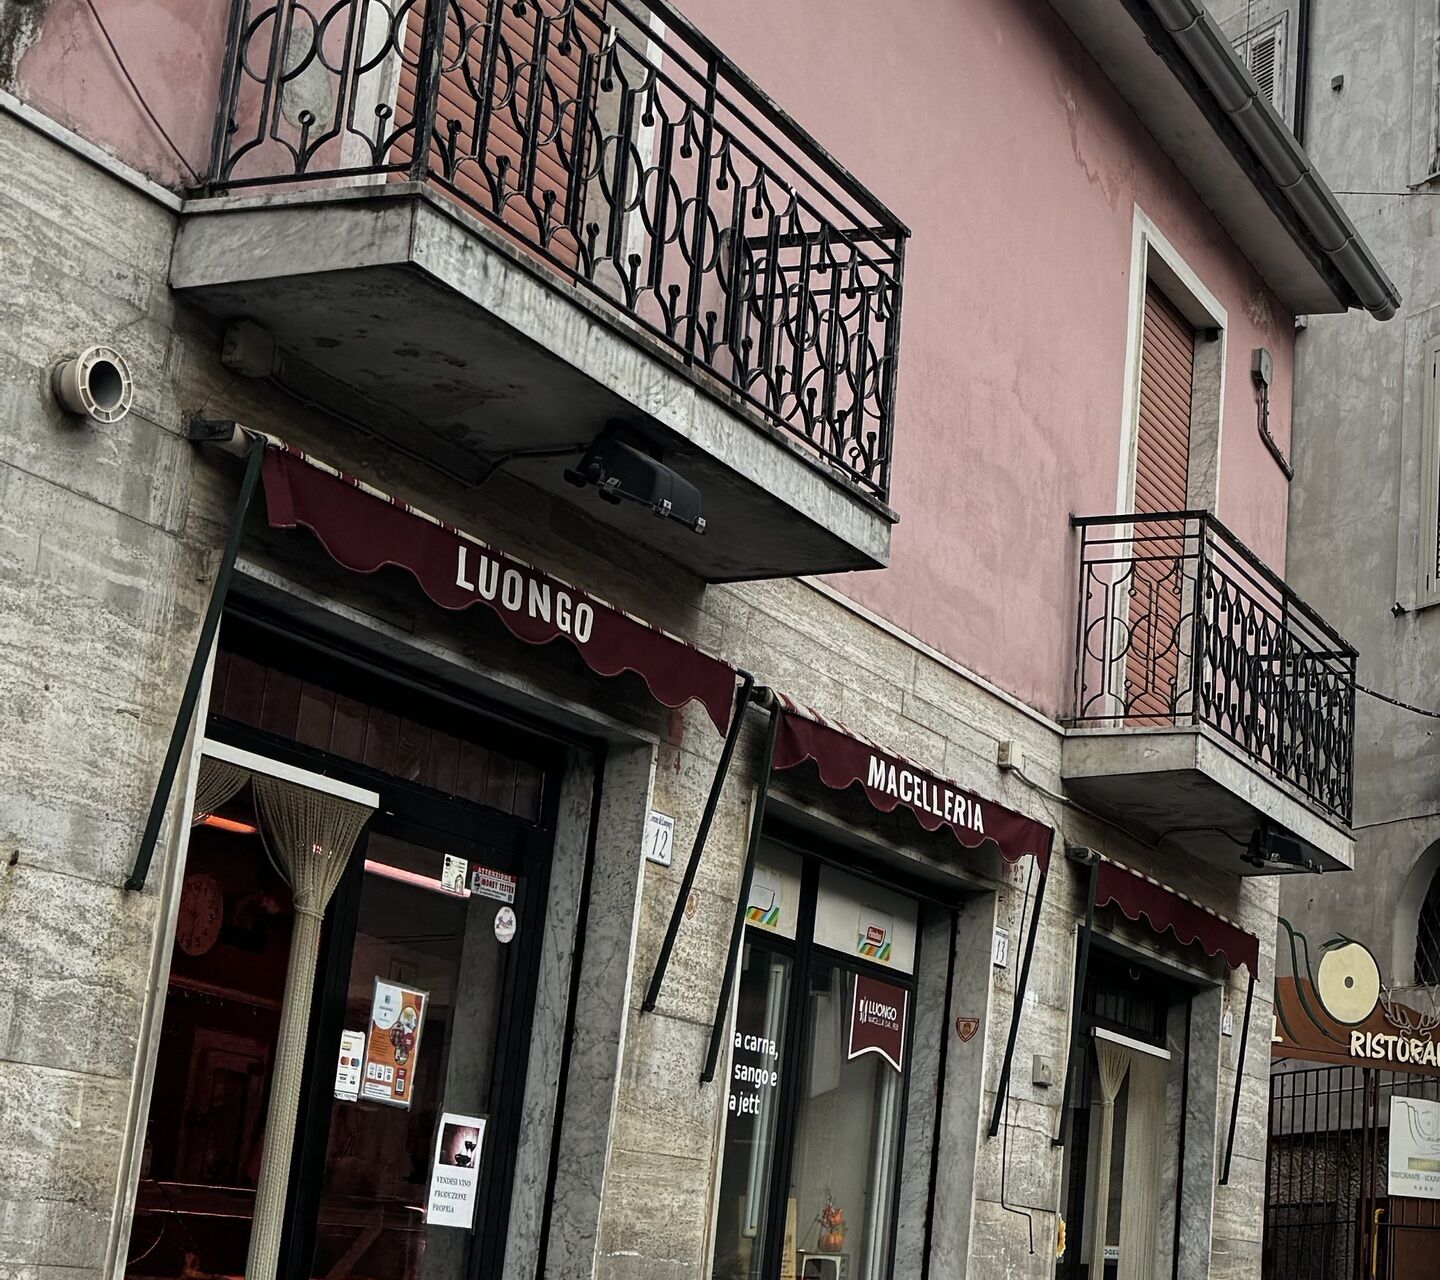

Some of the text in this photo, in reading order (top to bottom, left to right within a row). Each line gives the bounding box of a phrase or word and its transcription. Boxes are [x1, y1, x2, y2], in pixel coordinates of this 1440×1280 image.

[456, 545, 594, 644] LUONGO
[867, 754, 984, 834] MACELLERIA
[652, 828, 668, 859] 12
[478, 866, 512, 882] ATTENZIONE
[869, 1000, 897, 1021] LUONGO
[744, 1034, 779, 1061] carna,
[734, 1063, 778, 1089] sango e
[736, 1090, 761, 1117] jett
[1390, 1171, 1420, 1181] RISTORANTE
